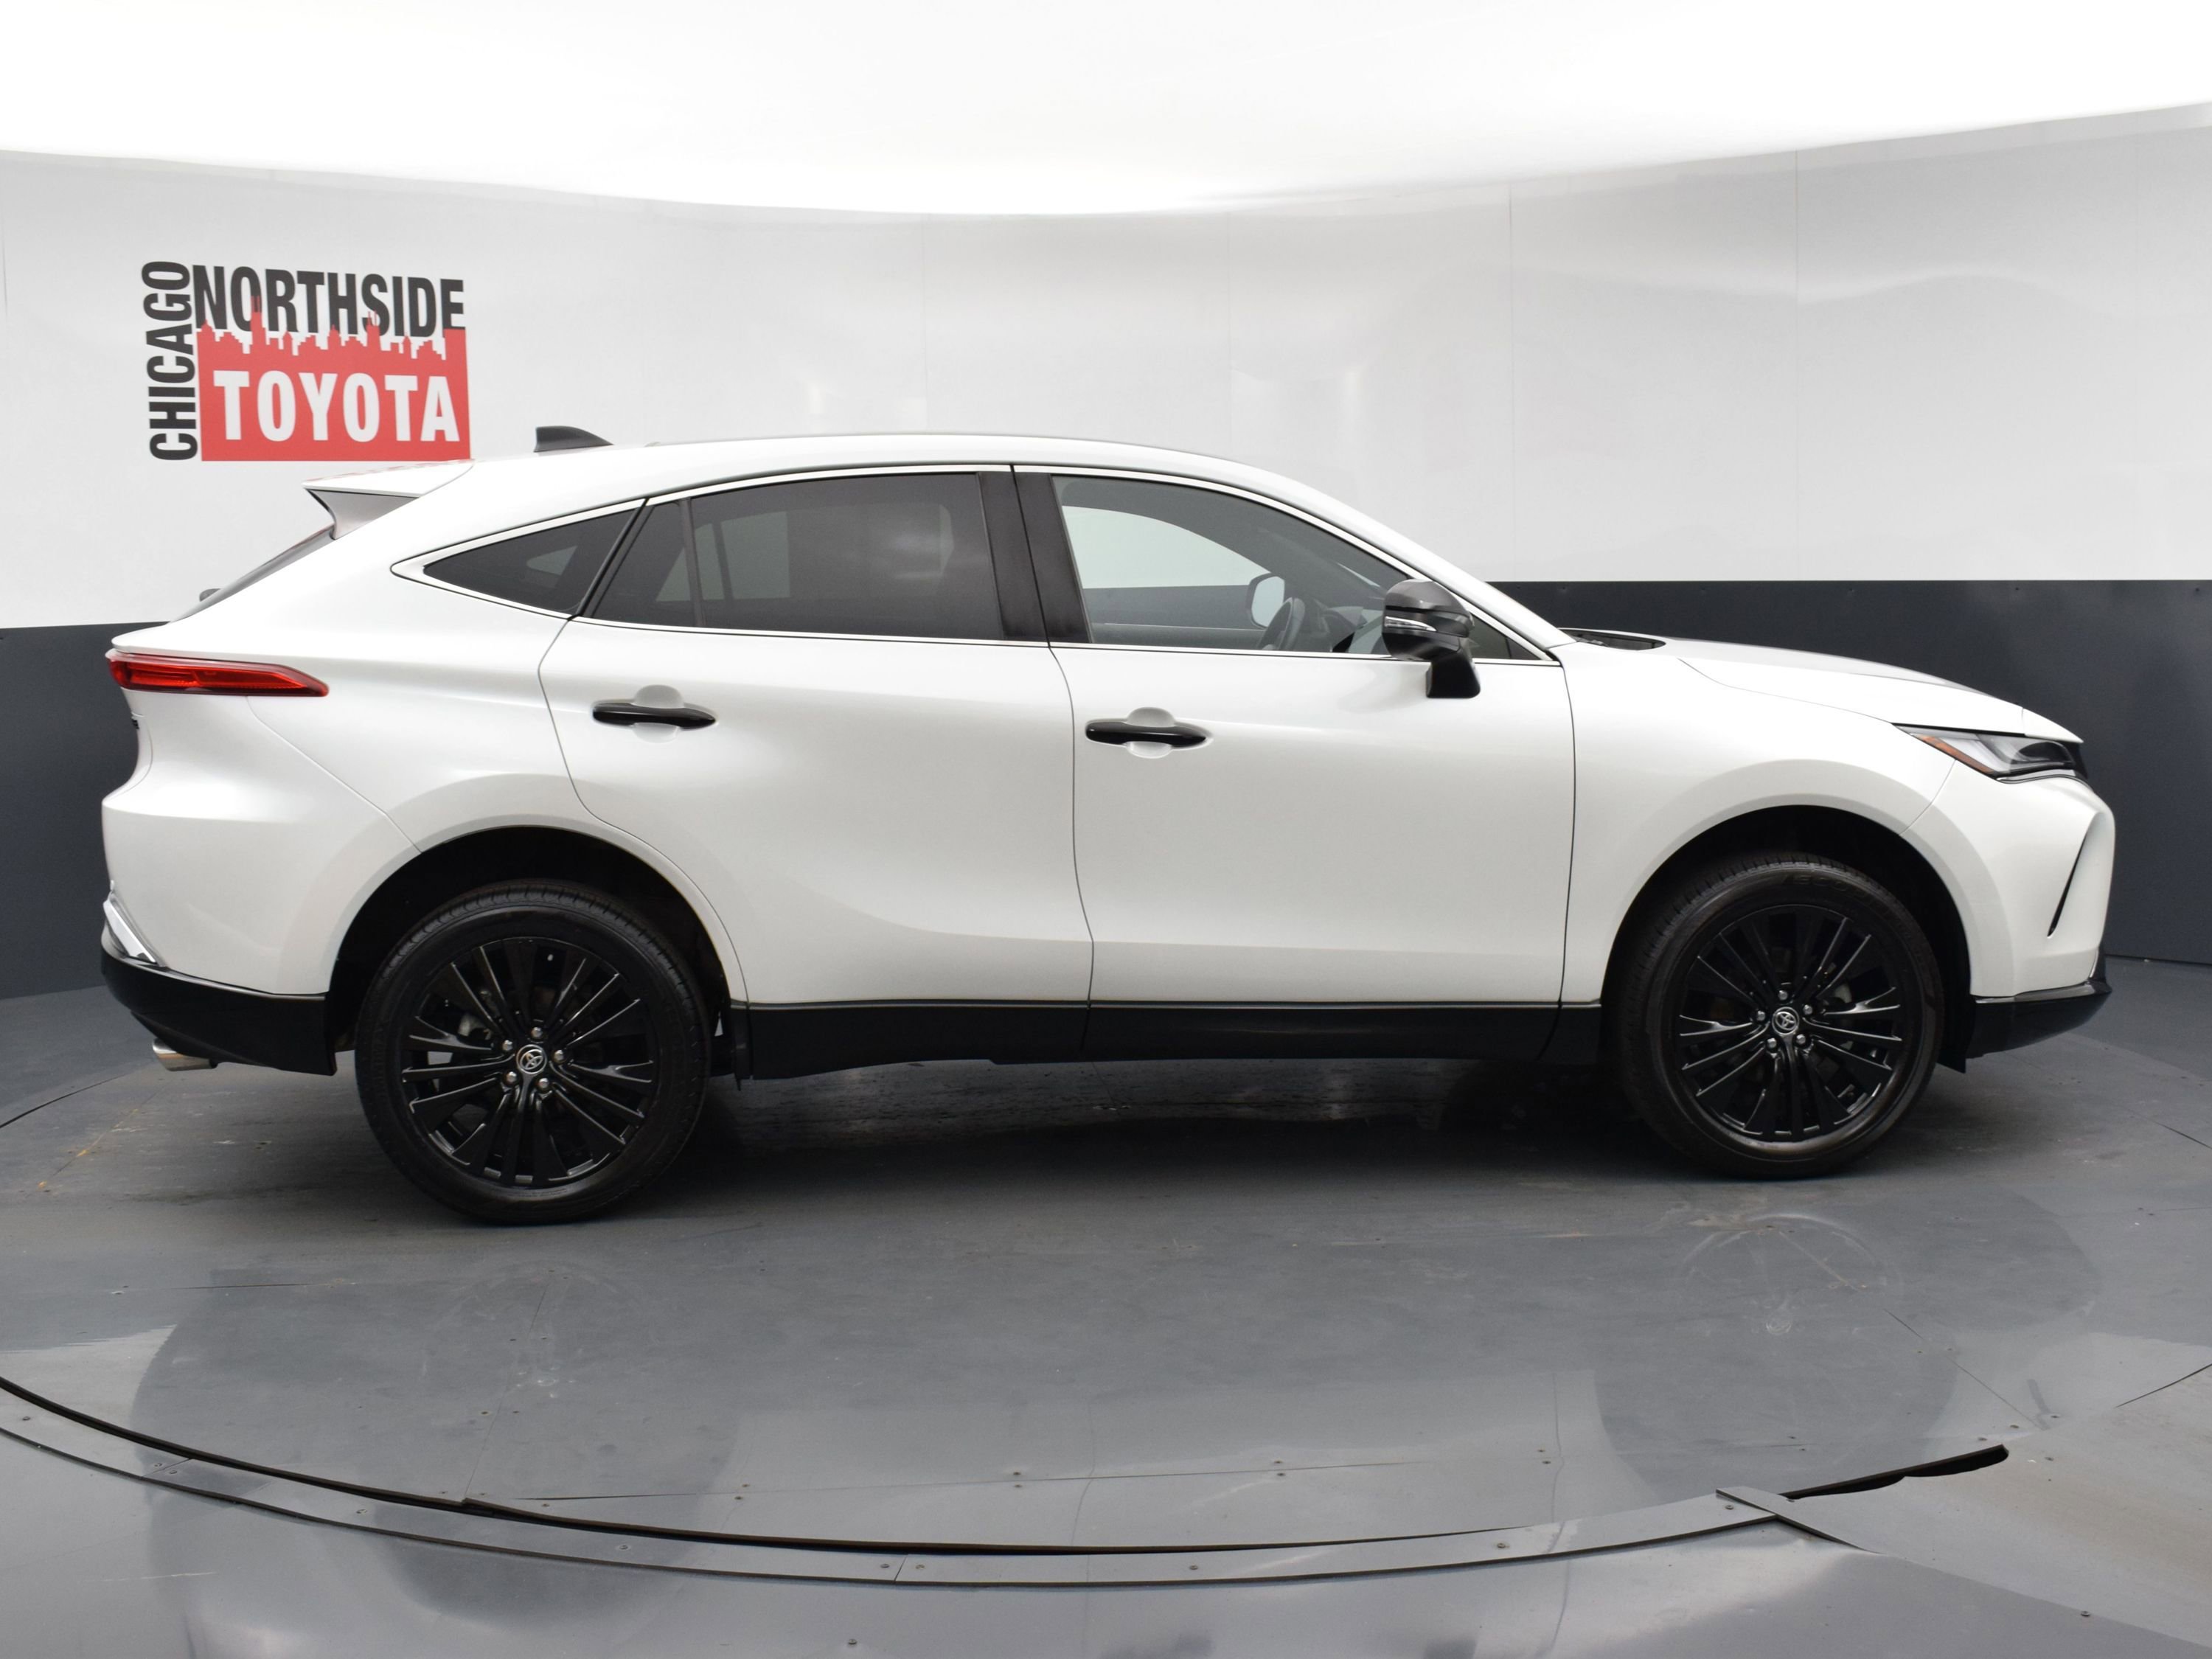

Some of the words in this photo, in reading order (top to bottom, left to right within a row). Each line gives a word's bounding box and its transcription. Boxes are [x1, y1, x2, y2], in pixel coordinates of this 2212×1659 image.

[192, 265, 465, 338] NORTHSIDE
[142, 261, 198, 461] CHICAGO
[213, 370, 460, 442] TOYOTA
